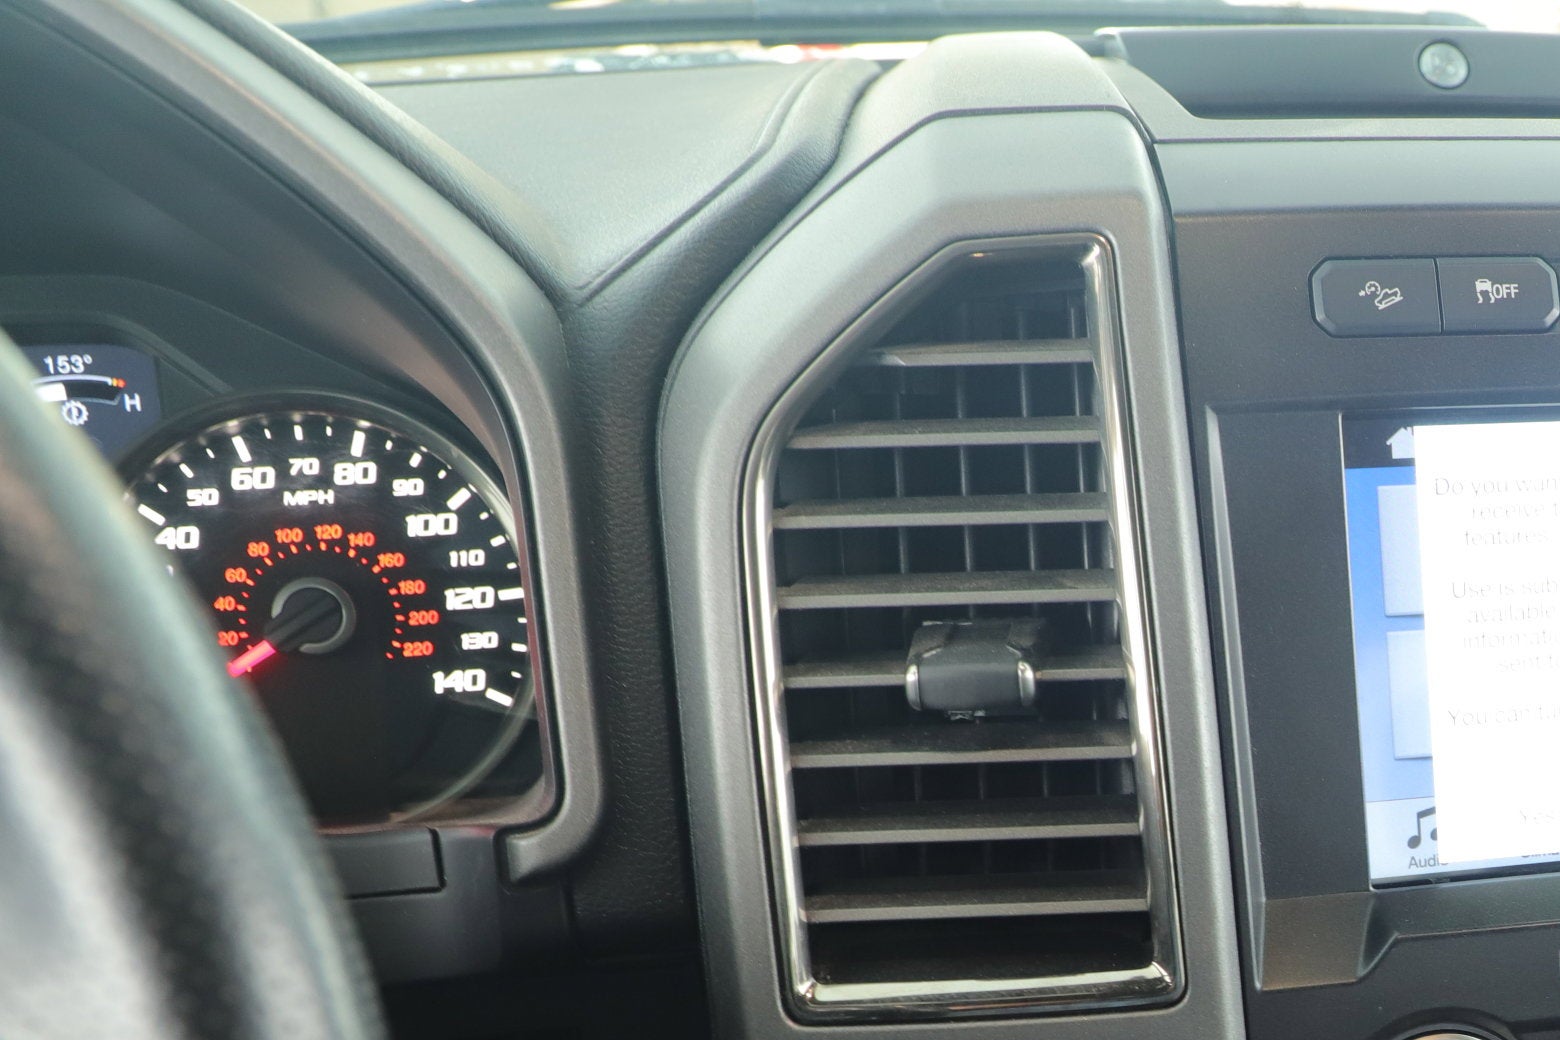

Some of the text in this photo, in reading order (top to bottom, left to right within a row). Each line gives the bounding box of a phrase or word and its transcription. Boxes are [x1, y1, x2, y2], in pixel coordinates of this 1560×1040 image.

[1493, 284, 1519, 298] OFF
[43, 354, 93, 374] 153°
[124, 393, 141, 412] H
[288, 457, 320, 476] 70
[333, 461, 377, 486] 80
[231, 466, 276, 490] 60
[1434, 477, 1464, 496] Do
[1471, 479, 1509, 497] you
[392, 478, 425, 497] 90
[186, 488, 219, 507] 50
[283, 489, 335, 506] MPH
[314, 524, 343, 540] 120
[405, 512, 458, 537] 100
[155, 525, 200, 550] 40
[275, 527, 304, 544] 100
[347, 531, 376, 547] 140
[247, 541, 270, 557] 80
[449, 549, 485, 567] 110
[377, 552, 405, 568] 160
[225, 567, 247, 583] 60
[398, 579, 426, 595] 180
[1451, 581, 1491, 599] Use
[214, 595, 236, 611] 40
[444, 586, 495, 610] 120
[408, 609, 439, 626] 200
[217, 630, 239, 646] 20
[461, 631, 498, 650] 130
[402, 641, 433, 657] 220
[433, 668, 486, 694] 140
